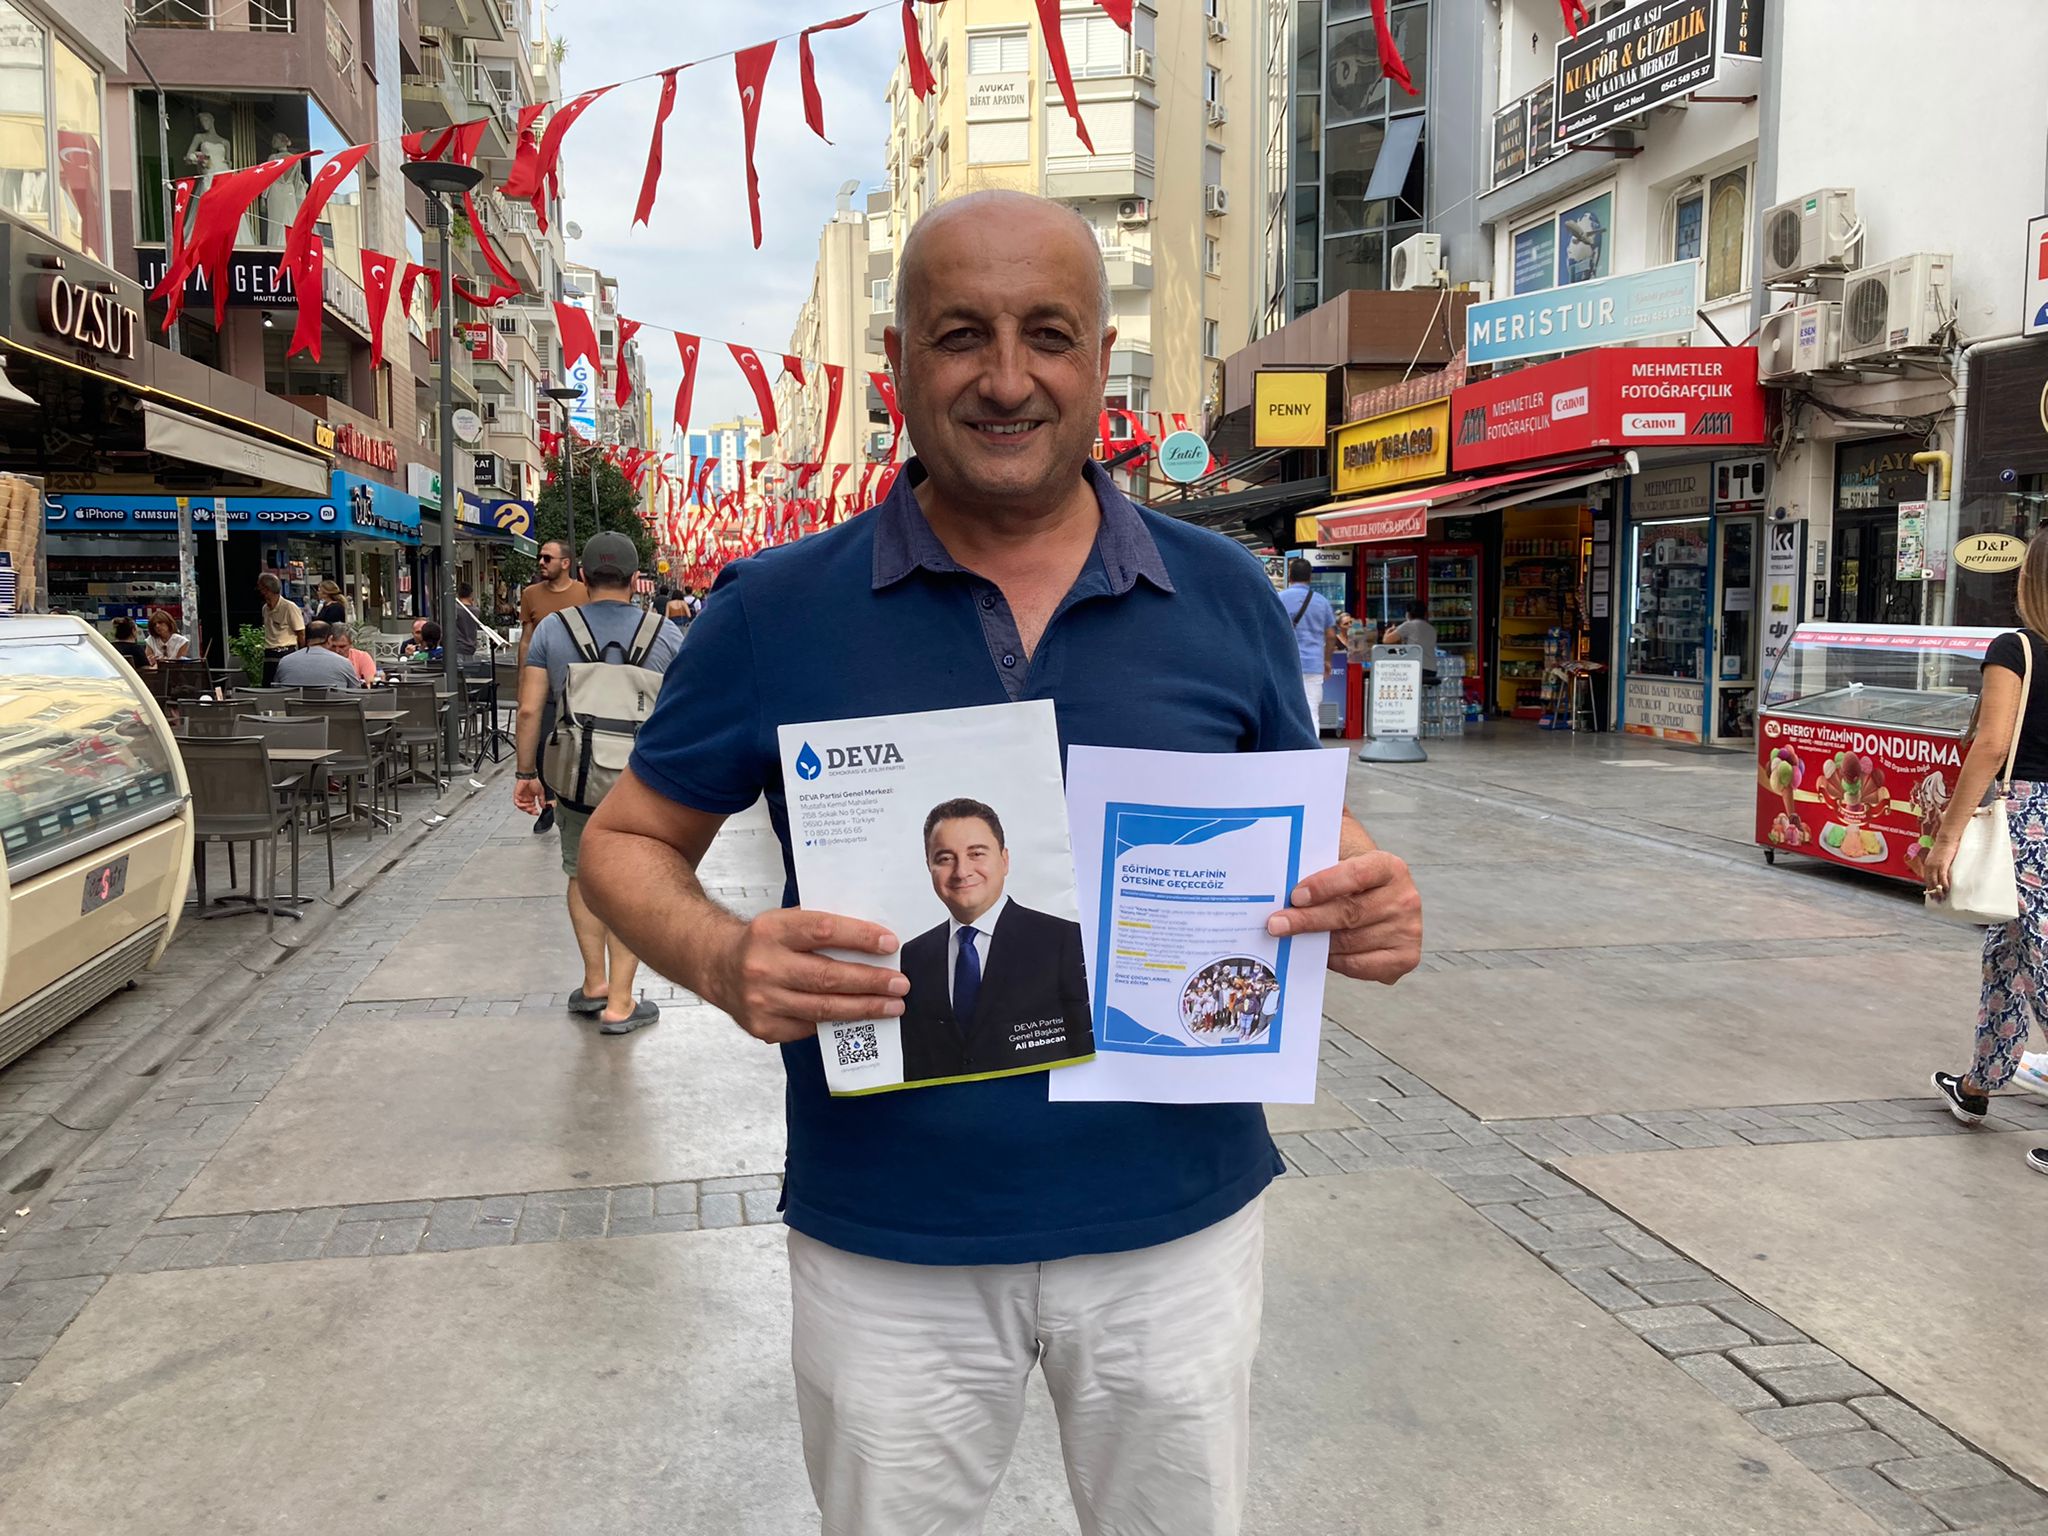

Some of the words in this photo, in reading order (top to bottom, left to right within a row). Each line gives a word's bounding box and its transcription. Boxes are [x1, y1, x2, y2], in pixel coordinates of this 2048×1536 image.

[1606, 20, 1632, 45] MUTLU
[1642, 5, 1662, 28] ASLI
[1565, 48, 1618, 94] KUAFÖR
[1621, 42, 1633, 67] &
[1637, 6, 1706, 60] GÜZELLİK
[1585, 84, 1601, 103] SAÇ
[1602, 67, 1638, 96] KAYNAK
[1639, 46, 1679, 79] MERKEZİ
[979, 83, 1015, 93] AVUKAT
[52, 256, 138, 360] ÖZSÜT
[1632, 363, 1722, 377] MEHMETLER
[1621, 382, 1733, 400] FOTOĞRAFÇILIK
[1269, 404, 1311, 416] PENNY
[1492, 392, 1544, 417] MEHMETLER
[1556, 395, 1585, 412] Canon
[1487, 414, 1550, 440] FOTOĞRAFÇILIK
[1632, 418, 1676, 429] Canon
[1343, 443, 1378, 470] PENNY
[1381, 427, 1436, 463] TOBACCO
[85, 508, 124, 520] iPhone
[135, 511, 178, 520] SAMSUN
[1976, 540, 2009, 552] D&P
[1964, 553, 2018, 564] perfumum
[1783, 724, 1815, 738] ENERGY
[1817, 726, 1854, 743] VİTAMİN
[826, 743, 904, 769] DEVA
[1853, 732, 1961, 767] DONDURMA
[800, 793, 819, 801] DEVA
[820, 792, 842, 800] Partisi
[843, 790, 863, 798] Genel
[801, 802, 826, 810] Mustafa
[853, 826, 862, 834] 65
[1122, 864, 1171, 877] EĞİTİMDE
[1173, 867, 1227, 879] TELAFİNİN
[1121, 875, 1164, 887] ÖTESİNE
[1167, 879, 1224, 889] GEÇECEĞİZ
[1014, 1022, 1038, 1032] DEVA
[1039, 1017, 1064, 1027] Partisi
[1009, 1031, 1033, 1042] Genel
[1034, 1027, 1065, 1037] Başkanı
[1015, 1042, 1027, 1051] Ali
[1028, 1036, 1066, 1048] Babacan
